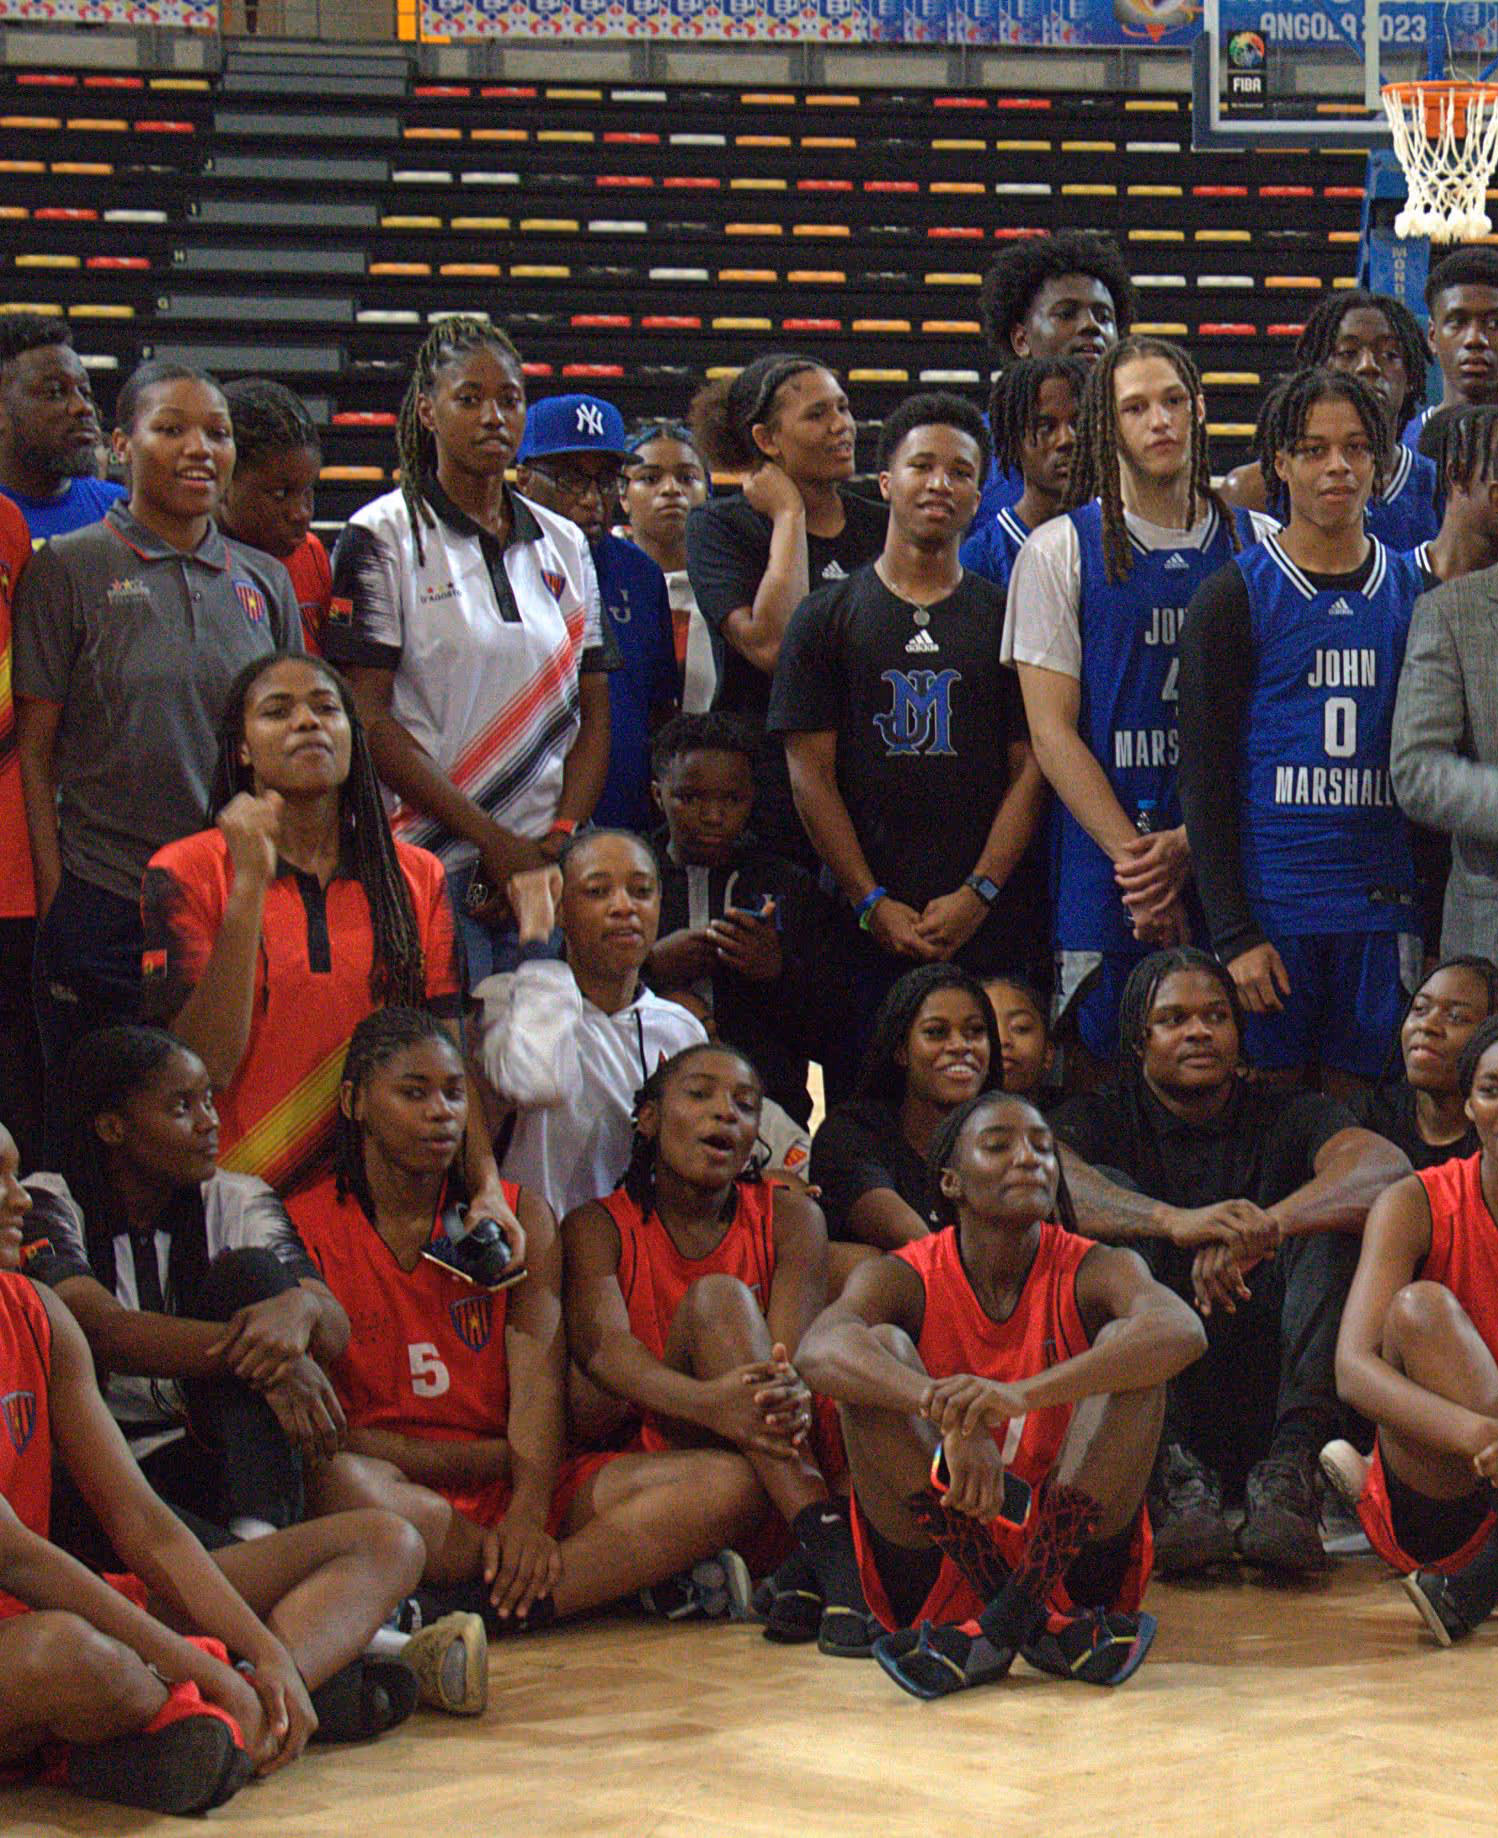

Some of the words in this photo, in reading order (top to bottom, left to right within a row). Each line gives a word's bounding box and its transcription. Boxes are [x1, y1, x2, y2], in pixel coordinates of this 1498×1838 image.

[1260, 12, 1357, 41] ANGOLA
[1362, 14, 1427, 41] 023
[1233, 77, 1261, 93] FIBA
[1308, 649, 1376, 687] JOHN
[1324, 697, 1357, 757] 0
[1275, 766, 1393, 806] MARSHALL
[408, 1342, 450, 1398] 5
